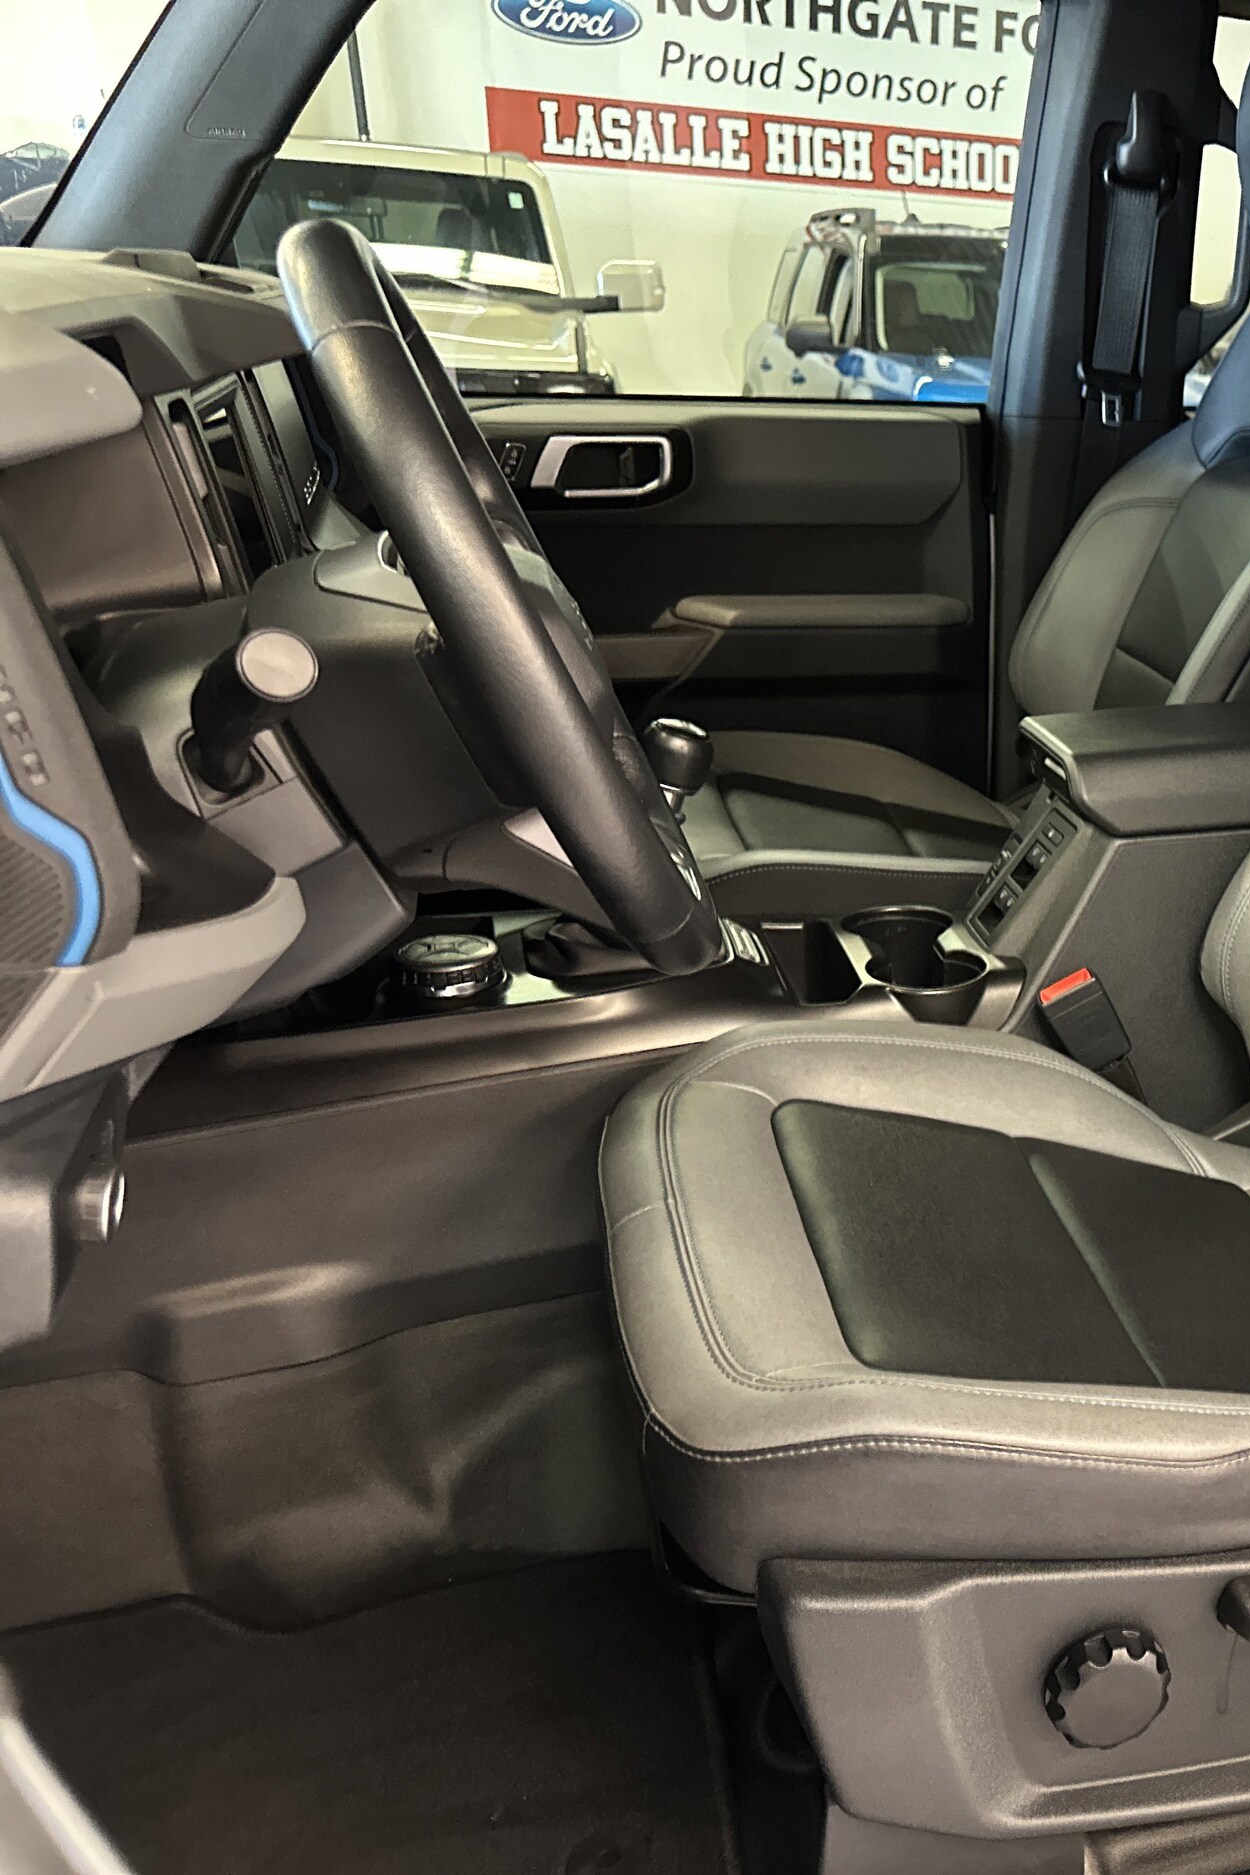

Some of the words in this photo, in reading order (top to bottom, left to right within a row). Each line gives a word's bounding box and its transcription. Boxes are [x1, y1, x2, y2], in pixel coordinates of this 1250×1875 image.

[519, 0, 616, 37] Ford
[660, 40, 785, 90] Proud
[795, 55, 957, 107] Sponsor
[966, 75, 1007, 111] of
[539, 99, 750, 171] LASALLE
[763, 121, 874, 182] HIGH
